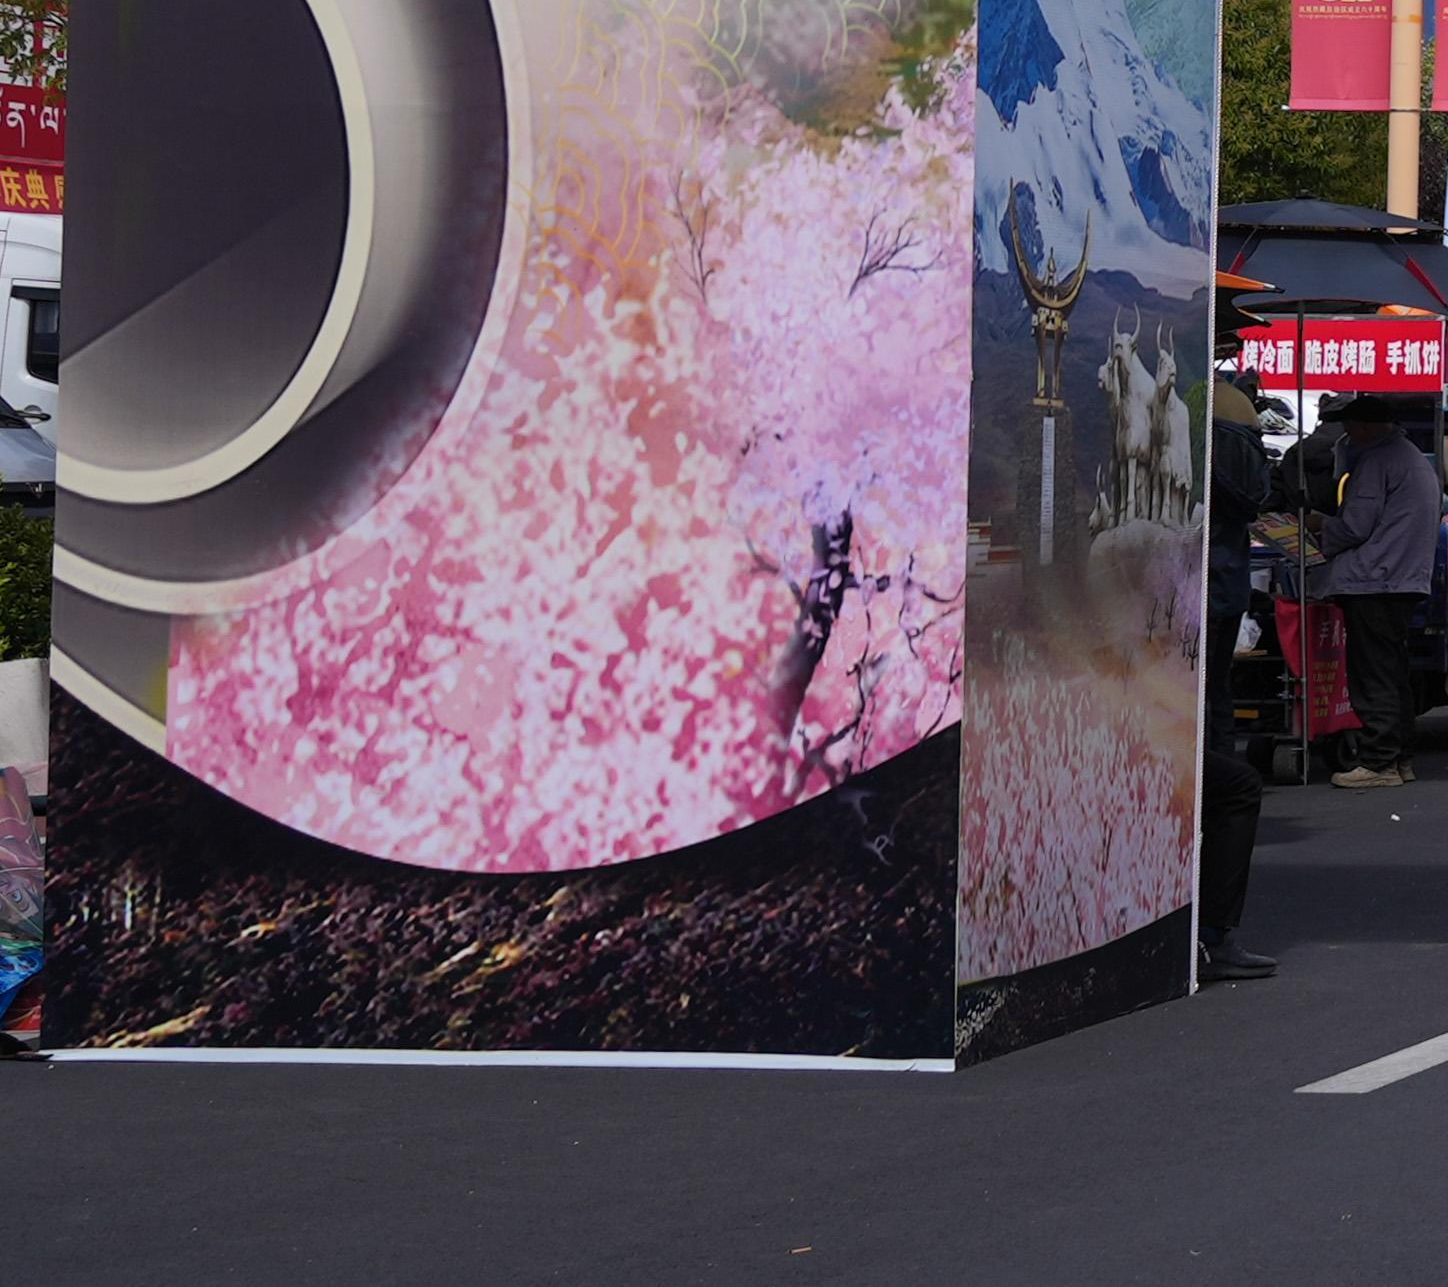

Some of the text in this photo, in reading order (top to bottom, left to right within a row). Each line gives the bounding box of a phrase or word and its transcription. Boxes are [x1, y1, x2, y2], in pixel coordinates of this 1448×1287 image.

[1241, 339, 1441, 376] 烤冷面 脆皮烤肠 手抓饼
